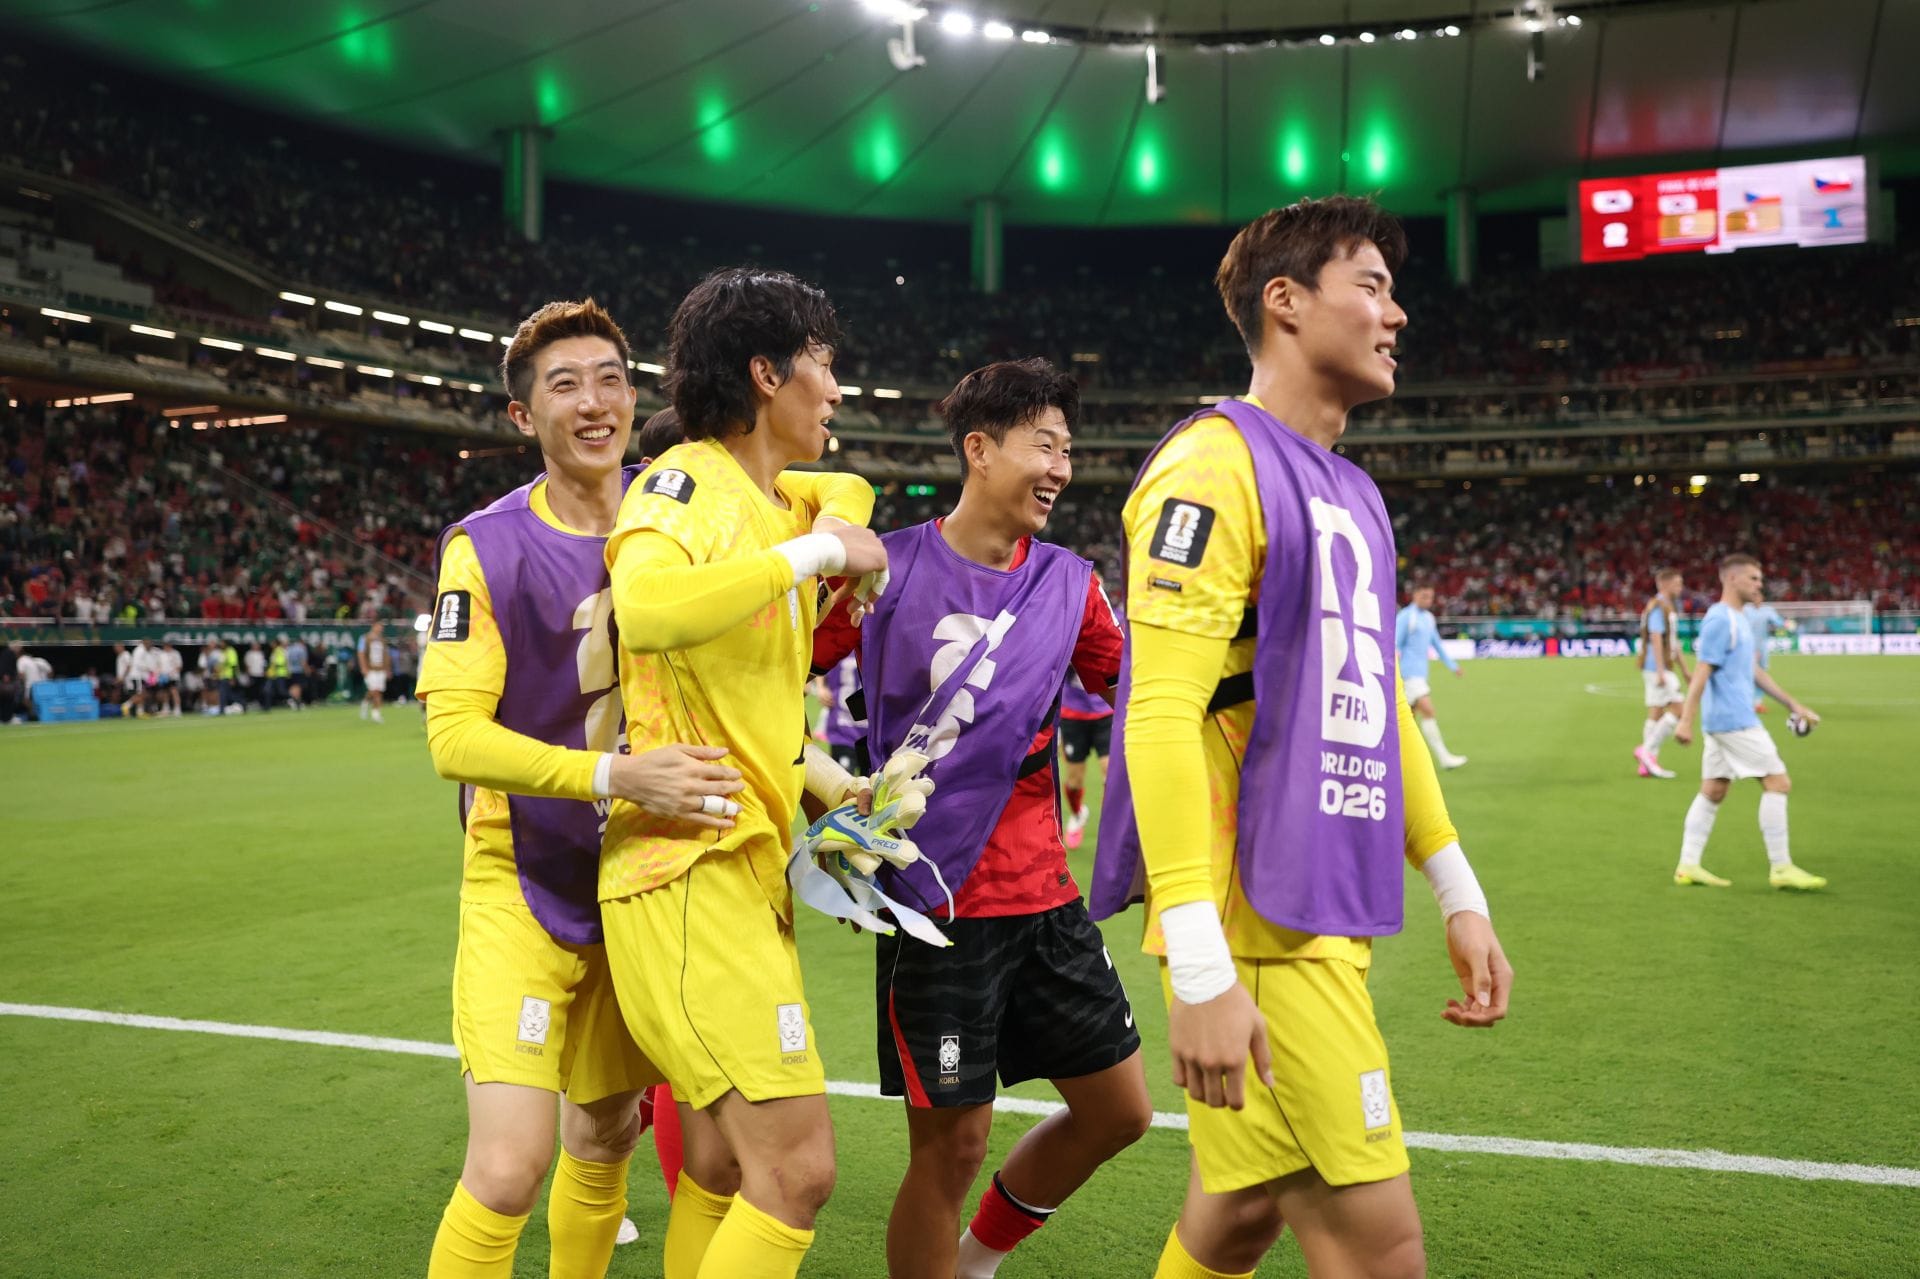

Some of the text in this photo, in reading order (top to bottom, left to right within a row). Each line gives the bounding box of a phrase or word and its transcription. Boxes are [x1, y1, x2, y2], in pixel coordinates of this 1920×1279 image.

[1560, 638, 1631, 658] ULTRA
[1330, 693, 1369, 724] FIFA
[1364, 758, 1387, 782] CUP
[1319, 779, 1387, 821] 026
[514, 1044, 544, 1057] KOREA
[781, 1054, 808, 1065] KOREA
[938, 1076, 960, 1085] KOREA
